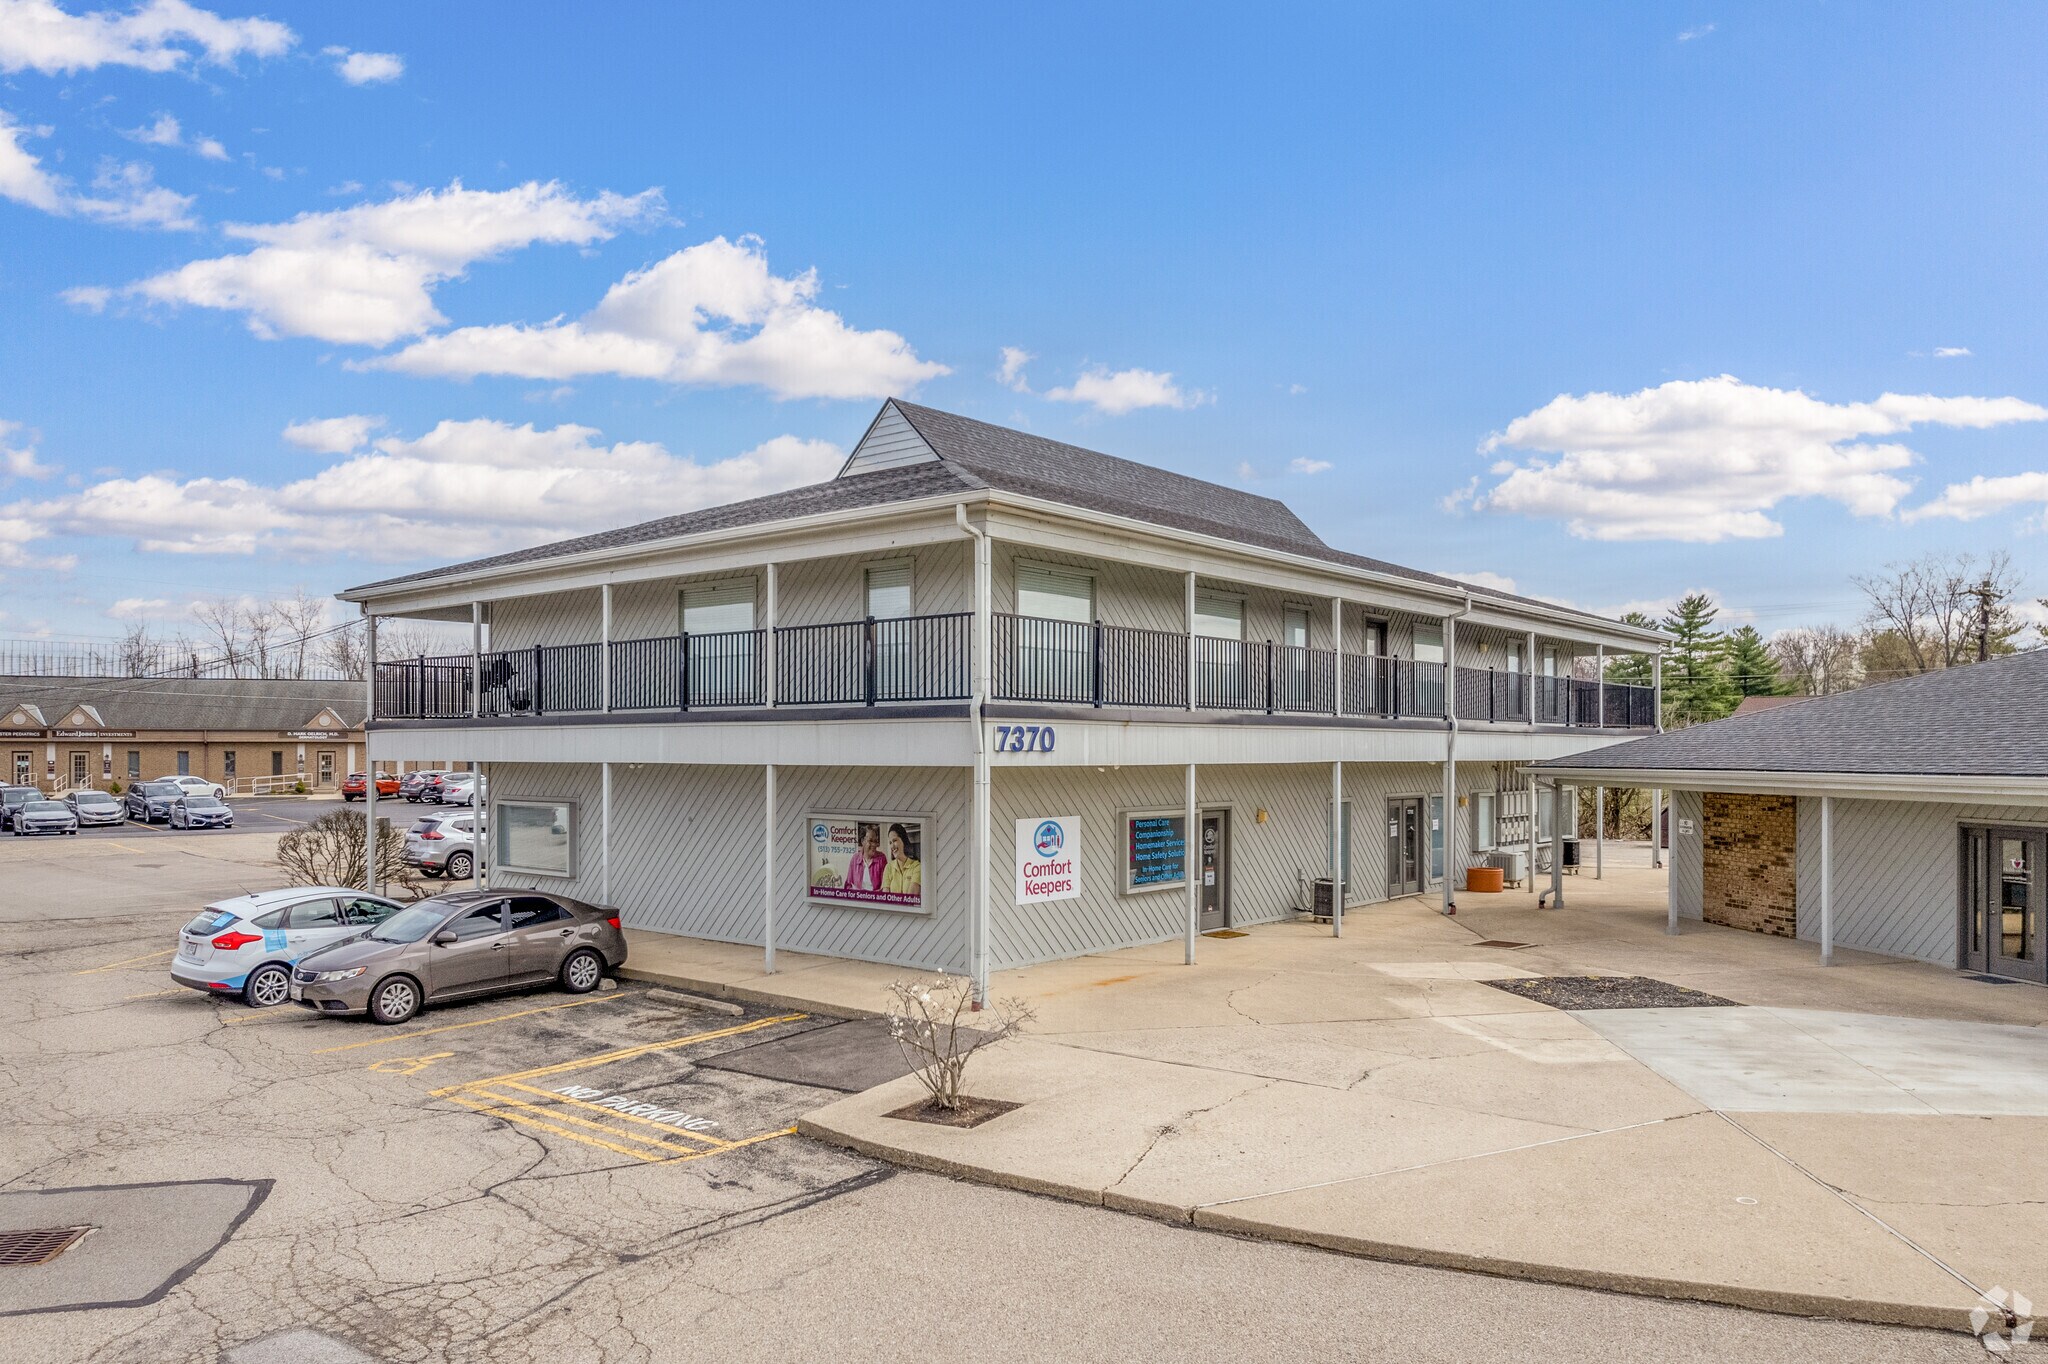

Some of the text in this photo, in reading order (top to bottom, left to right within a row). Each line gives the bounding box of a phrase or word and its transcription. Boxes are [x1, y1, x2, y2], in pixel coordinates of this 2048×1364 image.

[996, 726, 1055, 752] 7370
[830, 825, 857, 835] Comfort
[1136, 820, 1158, 828] Personal
[831, 835, 857, 844] Keepers
[1135, 829, 1174, 839] Companionship
[1136, 841, 1165, 850] Homemaker
[1136, 849, 1185, 861] Home Safety Solutio
[1023, 859, 1072, 878] Comfort
[1025, 879, 1072, 897] Keepers
[813, 888, 835, 896] In-Home
[836, 889, 847, 897] Care
[848, 890, 856, 898] for
[856, 891, 876, 900] Seniors
[887, 894, 902, 902] Other
[903, 896, 920, 904] Adults
[552, 1085, 719, 1131] NO PARKING
